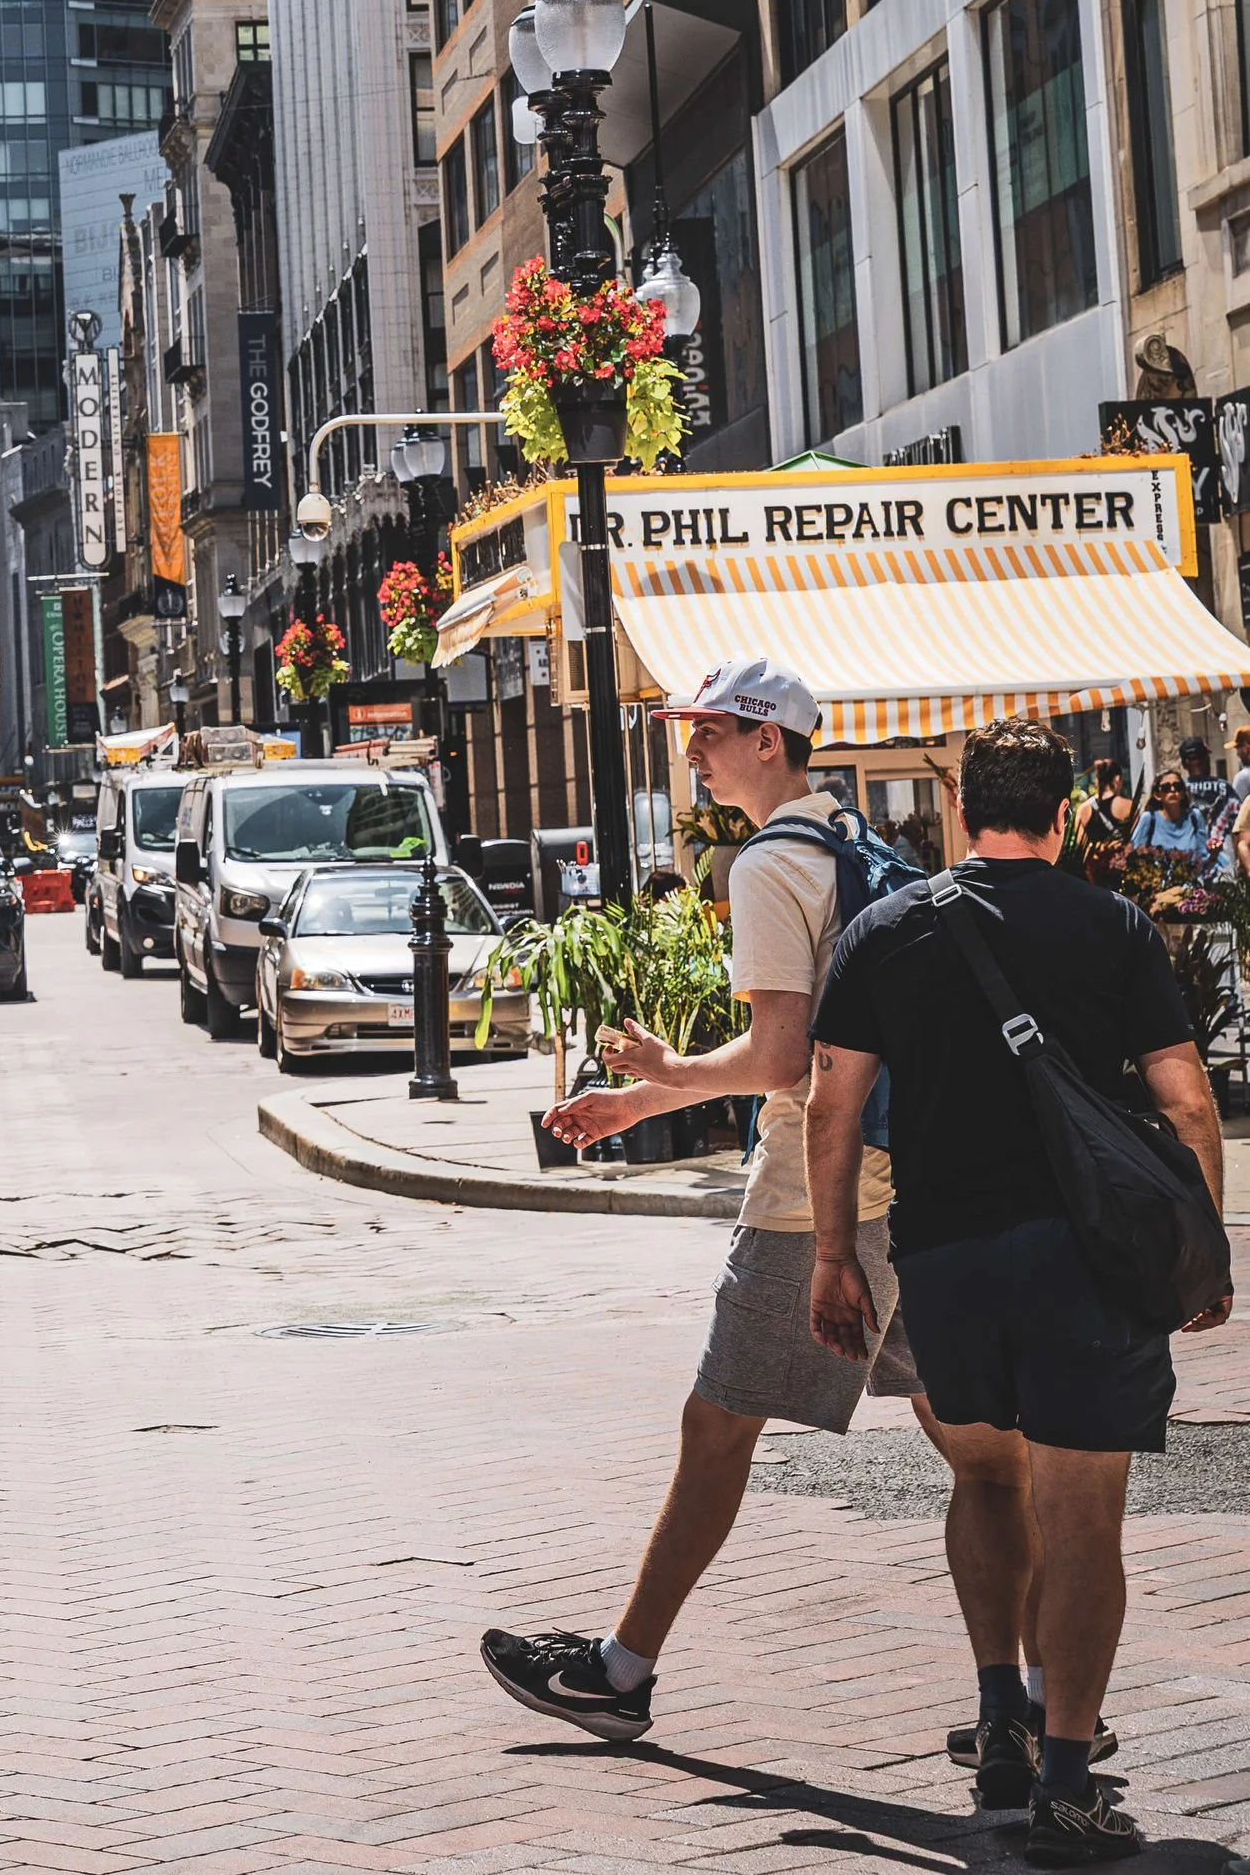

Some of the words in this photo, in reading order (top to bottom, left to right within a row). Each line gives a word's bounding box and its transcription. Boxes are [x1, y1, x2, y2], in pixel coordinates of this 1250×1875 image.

[248, 333, 267, 378] THE
[77, 366, 104, 545] MODERN
[250, 381, 273, 489] GODFREY
[569, 512, 634, 548] R.
[641, 507, 749, 547] PHIL
[764, 499, 925, 542] REPAIR
[946, 491, 1135, 533] CENTER
[52, 631, 65, 684] OPERA
[54, 687, 67, 741] HOUSE
[734, 694, 777, 711] CHICAGO
[739, 703, 769, 717] BULLS
